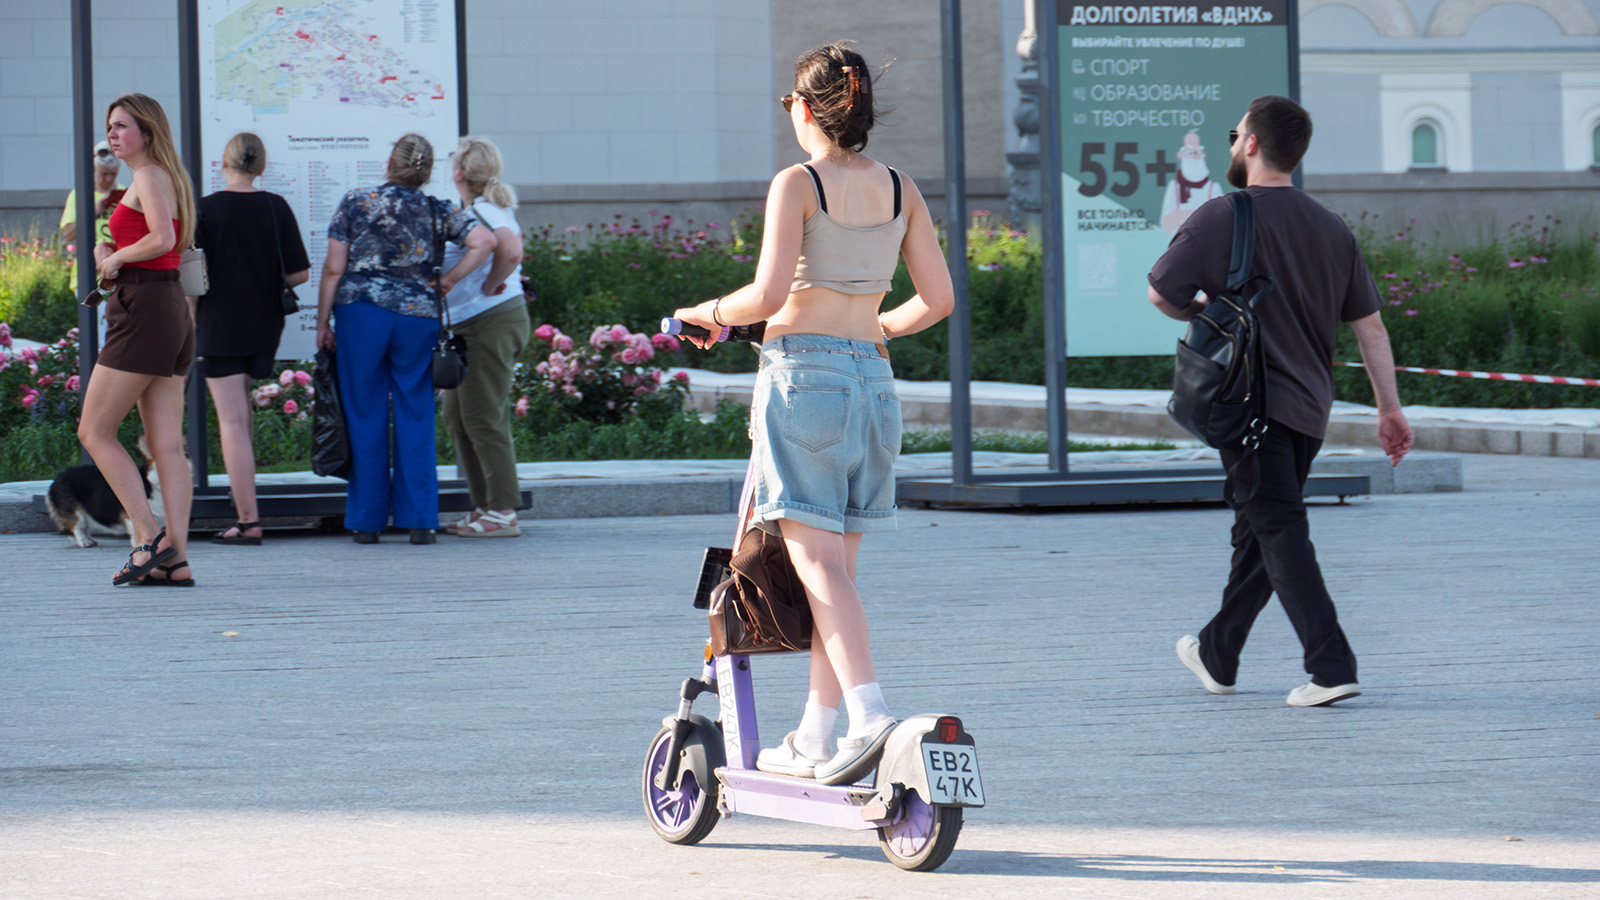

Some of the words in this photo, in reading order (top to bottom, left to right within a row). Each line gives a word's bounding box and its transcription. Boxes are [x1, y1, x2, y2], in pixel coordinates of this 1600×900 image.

[1071, 5, 1198, 26] ДОЛГОЛЕТИЯ
[1201, 6, 1273, 26] «ВДНХ»
[1072, 35, 1133, 48] ВЫБИРАЙТЕ
[1135, 37, 1194, 48] УВЛЕЧЕНИЕ
[1196, 37, 1210, 48] ПО
[1090, 58, 1151, 76] СПОРТ
[1090, 84, 1222, 101] ОБРАЗОВАНИЕ
[1091, 109, 1205, 127] ТВОРЧЕСТВО
[1077, 142, 1177, 198] 55+
[1077, 209, 1097, 220] ВСЕ
[1099, 208, 1145, 220] ТОЛЬКО
